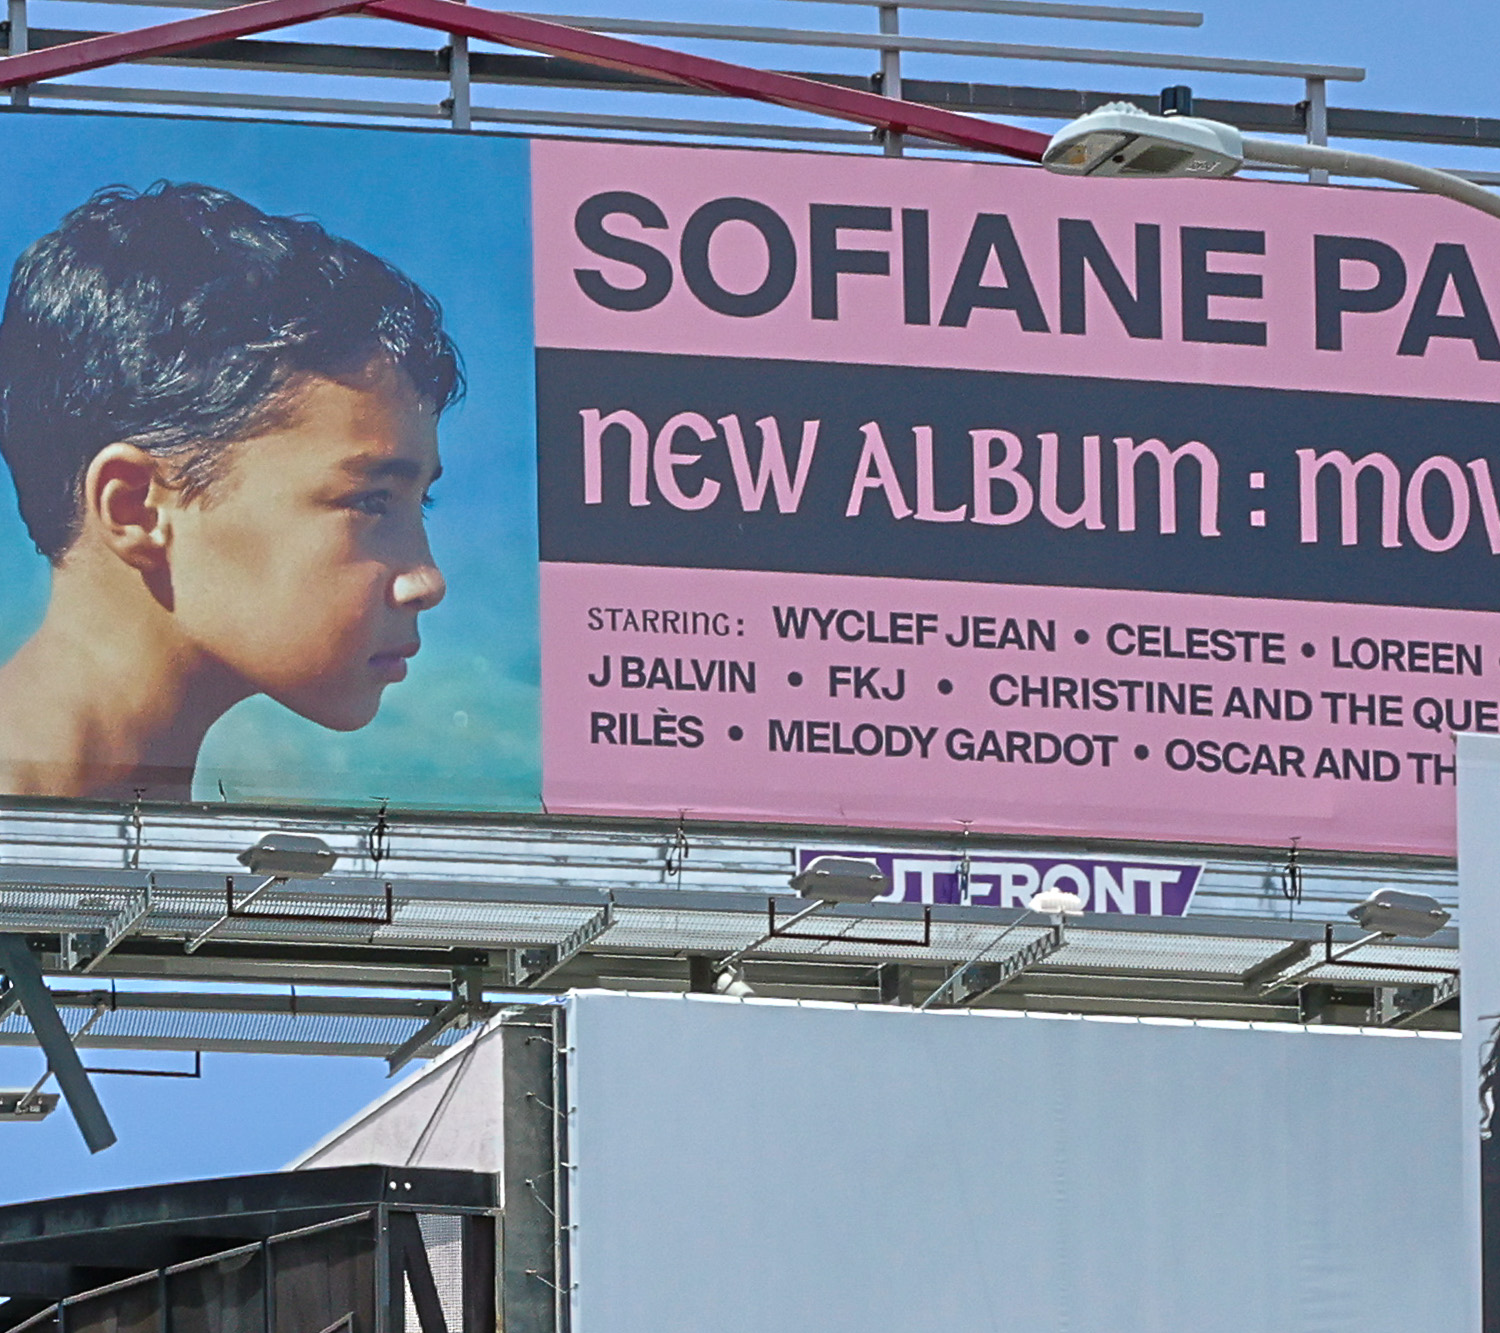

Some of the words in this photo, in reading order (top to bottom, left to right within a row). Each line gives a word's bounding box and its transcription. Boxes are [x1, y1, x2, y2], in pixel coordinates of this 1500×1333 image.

[572, 190, 1269, 350] SOFIANE
[772, 605, 939, 648] WYCLEF
[944, 616, 1057, 652] JEAN
[1105, 622, 1287, 665] CELESTE
[1331, 636, 1484, 677] LOREEN
[588, 655, 613, 689] J
[619, 656, 757, 695] BALVIN
[828, 665, 908, 702] FKJ
[988, 673, 1215, 717] CHRISTINE
[1221, 686, 1312, 723] AND
[1321, 691, 1404, 728] THE
[589, 707, 705, 749] RILÈS
[768, 718, 938, 761] MELODY
[944, 726, 1120, 769] GARDOT
[1164, 738, 1306, 778] OSCAR
[1313, 750, 1402, 784] AND
[1406, 752, 1457, 787] TH
[876, 858, 1183, 917] UTFRONT
